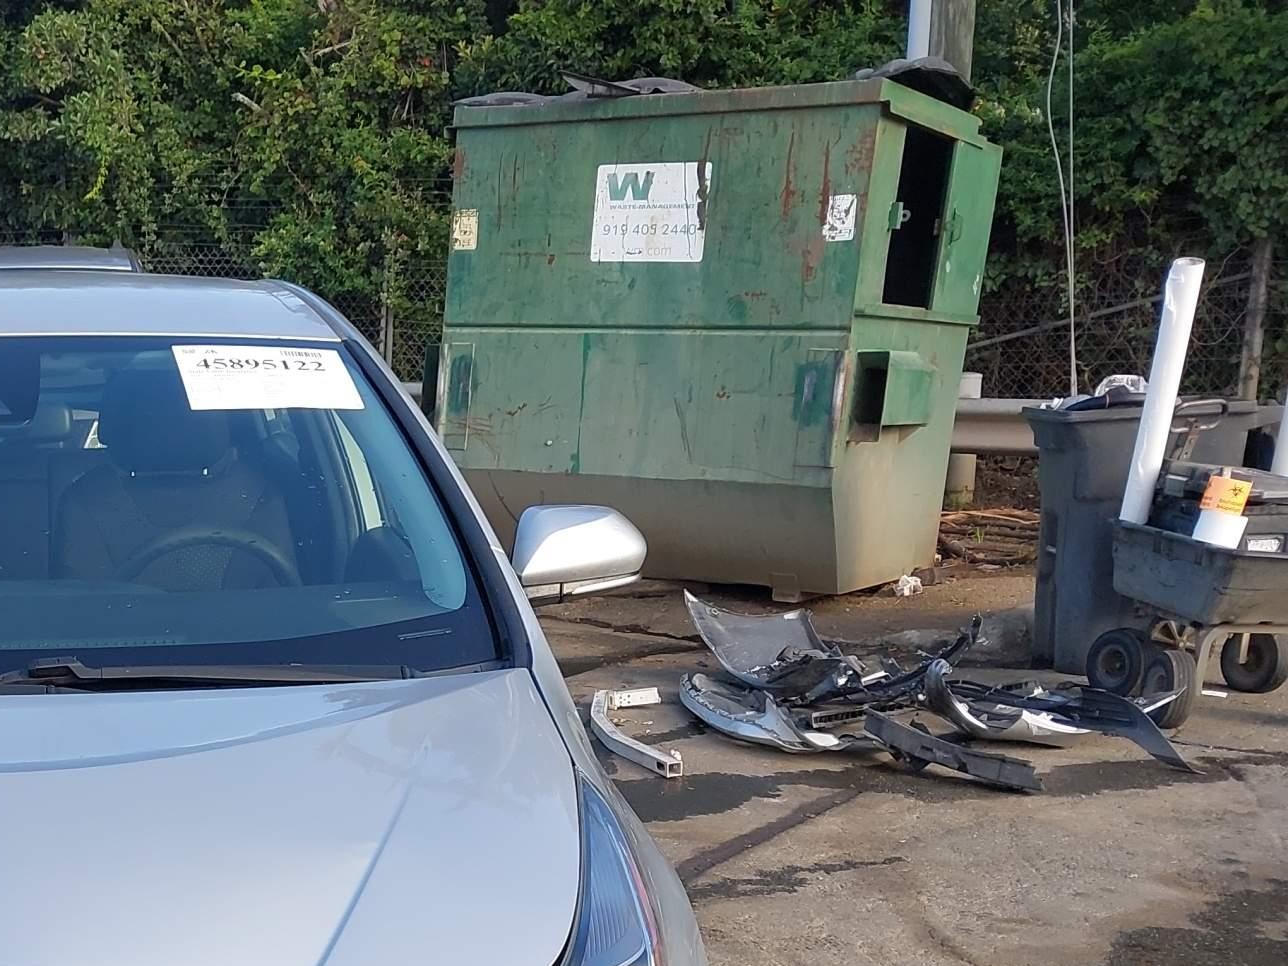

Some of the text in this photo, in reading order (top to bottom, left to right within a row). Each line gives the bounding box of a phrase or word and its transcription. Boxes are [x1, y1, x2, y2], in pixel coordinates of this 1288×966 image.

[602, 223, 697, 236] 919 405 2440
[196, 357, 326, 372] 45895122
